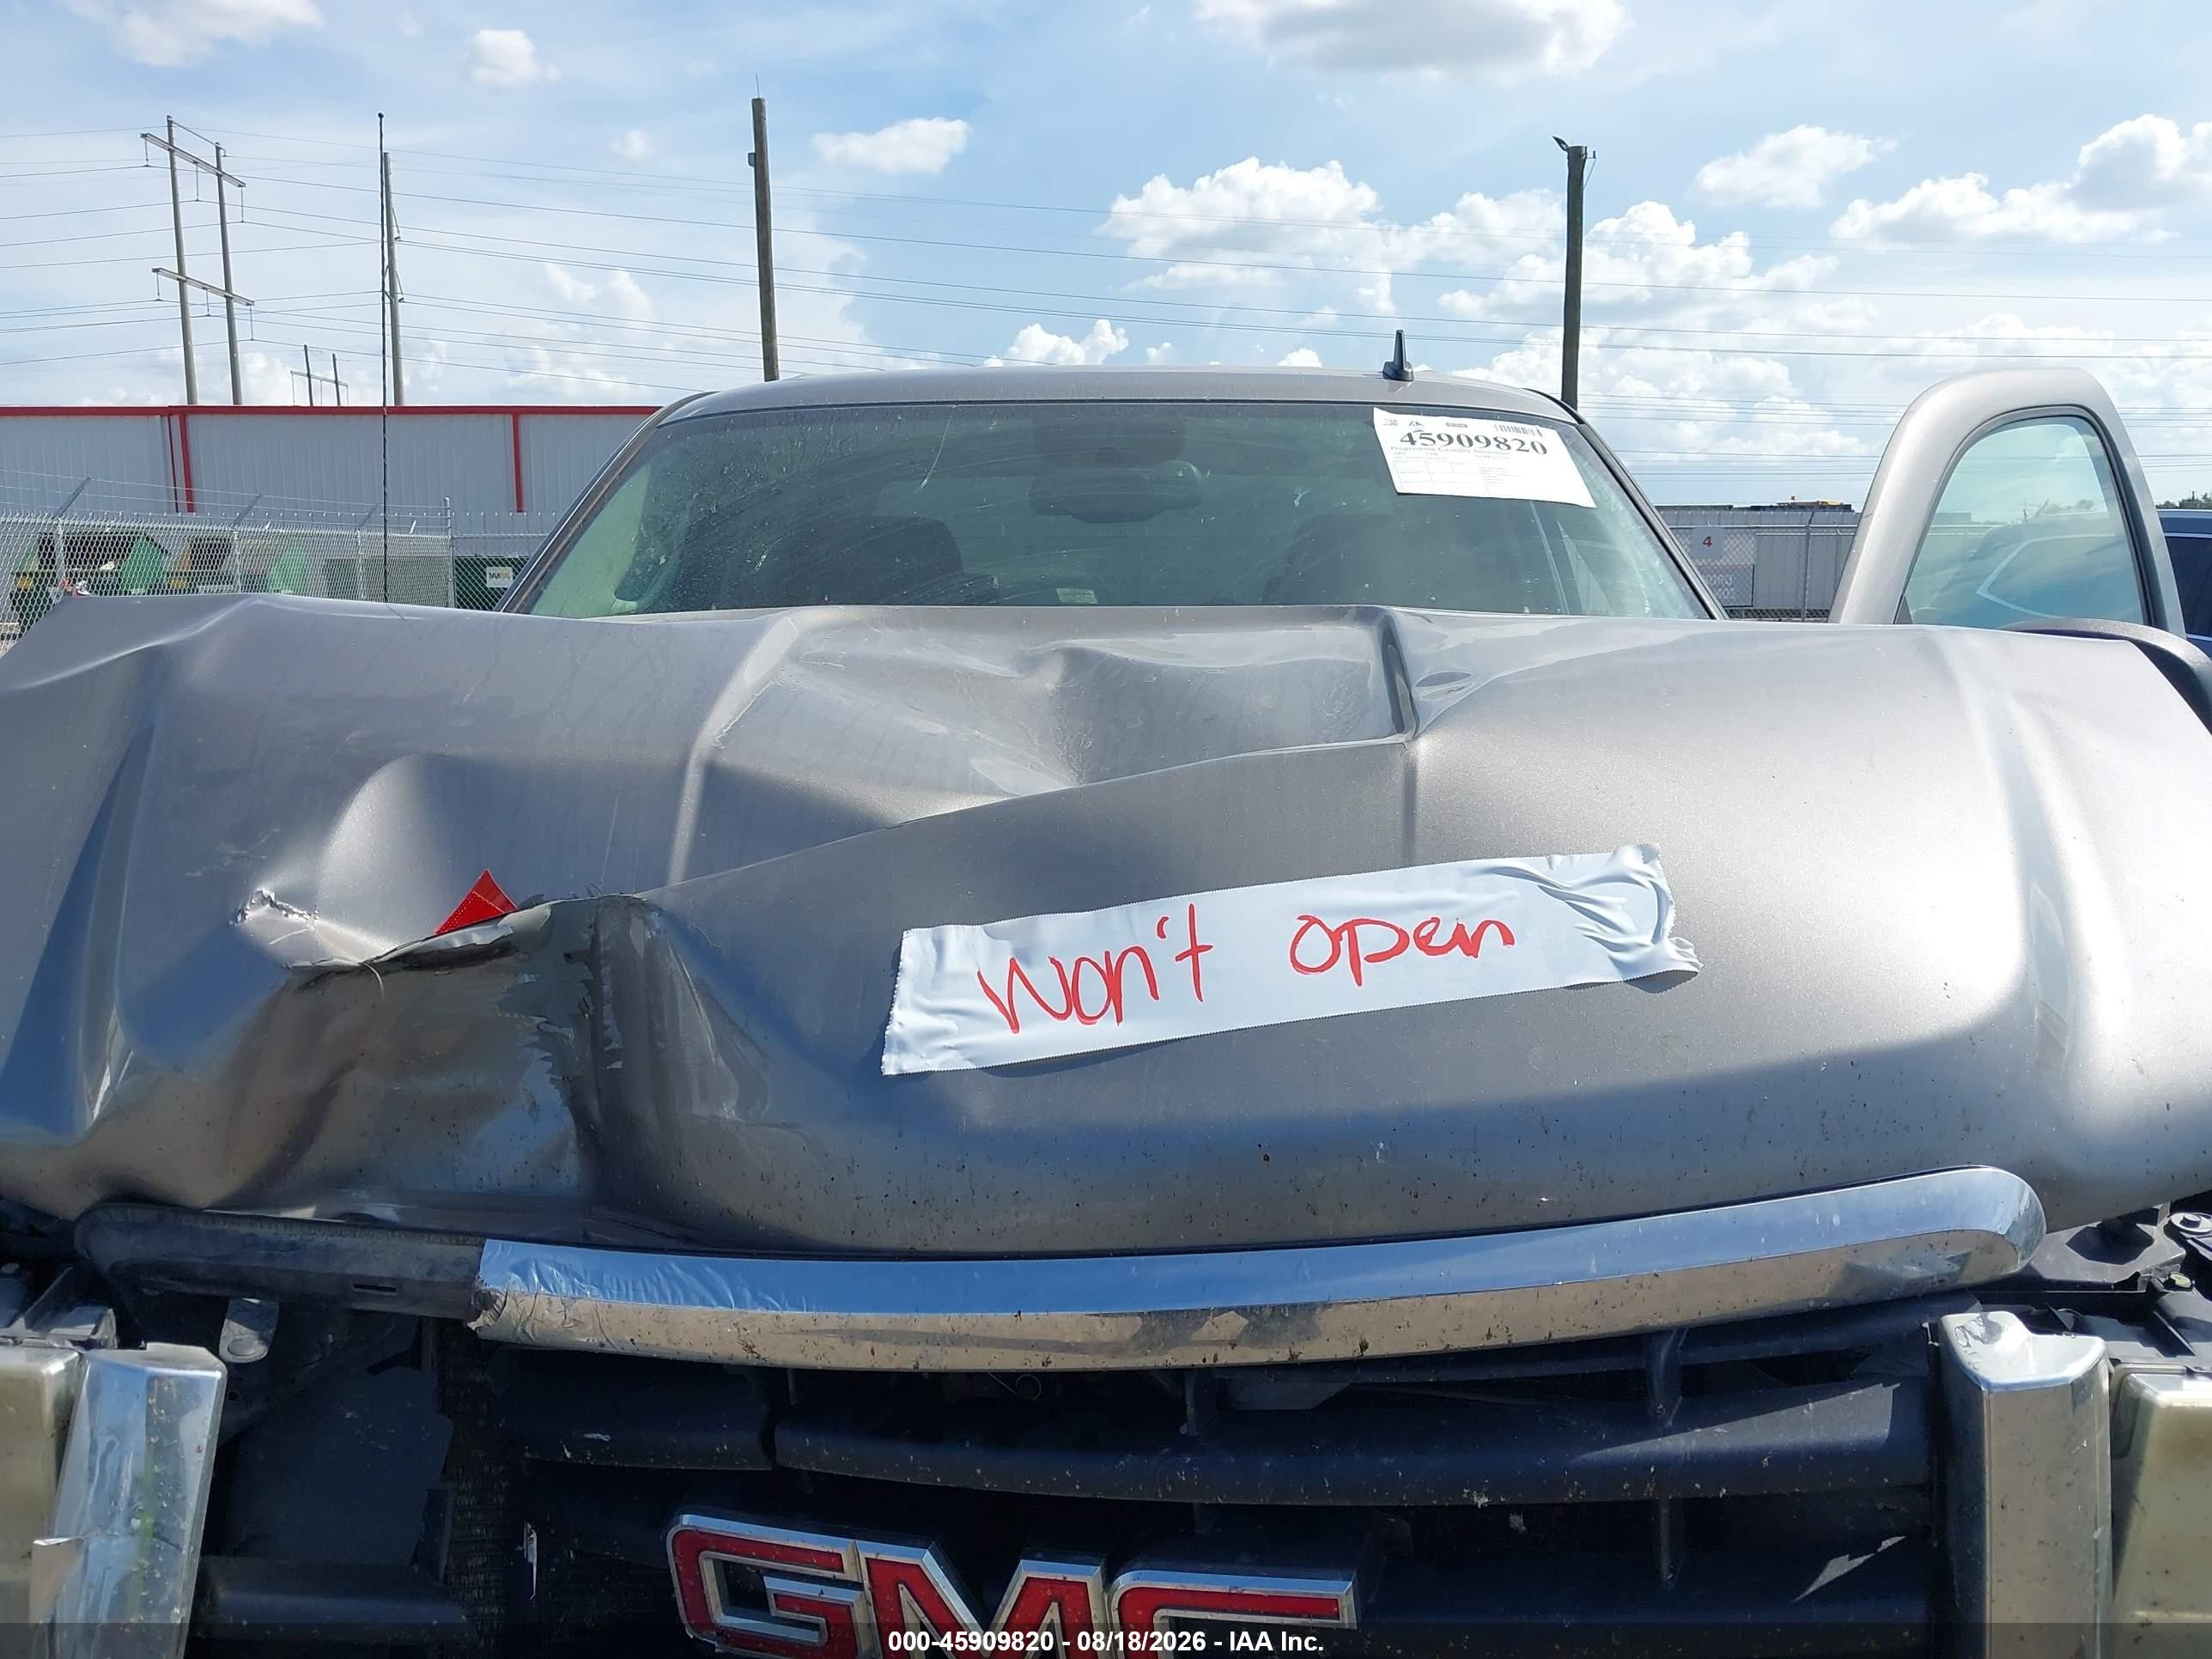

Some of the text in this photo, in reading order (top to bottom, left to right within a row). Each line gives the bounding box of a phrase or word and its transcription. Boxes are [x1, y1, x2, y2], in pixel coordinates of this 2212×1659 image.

[1400, 431, 1547, 455] 45909820
[1702, 536, 1712, 548] 4
[666, 1514, 1357, 1659] GMC
